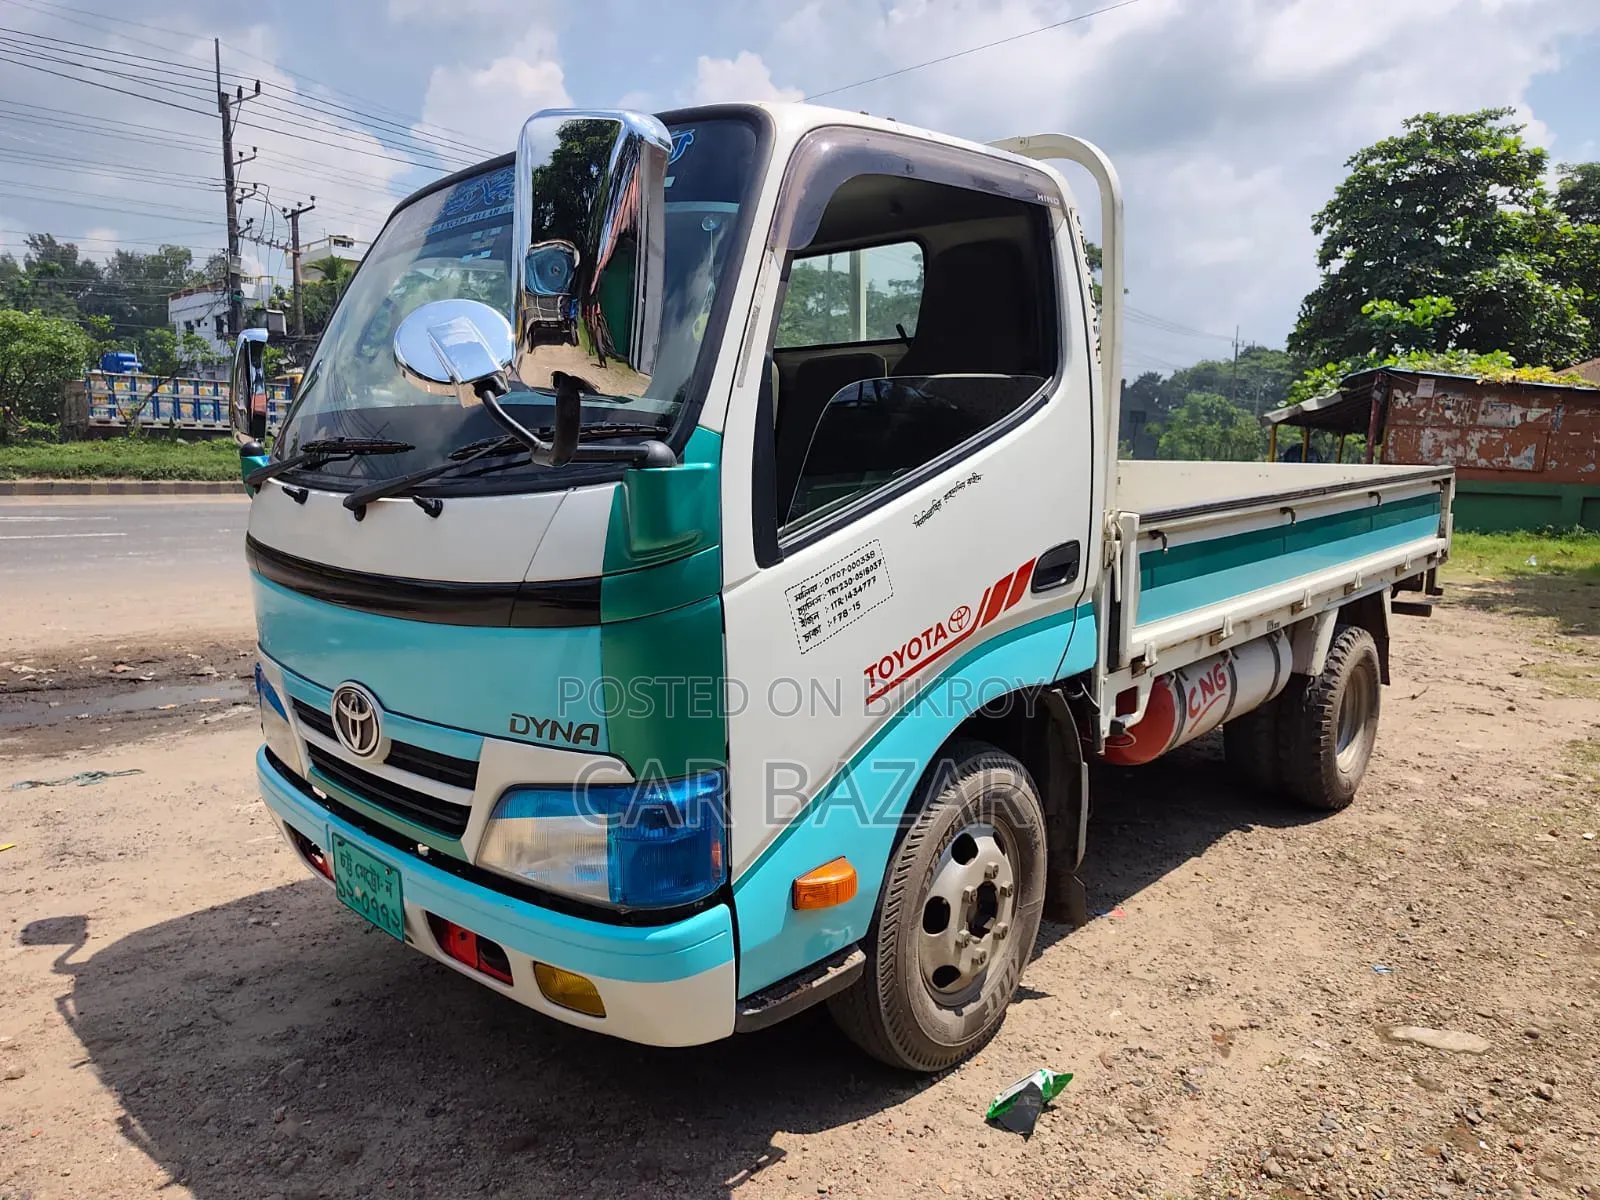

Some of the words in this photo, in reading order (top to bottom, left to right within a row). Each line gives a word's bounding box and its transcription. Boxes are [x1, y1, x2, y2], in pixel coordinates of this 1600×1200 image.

[864, 622, 948, 688] TOYOTA
[1188, 662, 1227, 719] CNG
[509, 713, 599, 746] DYNA
